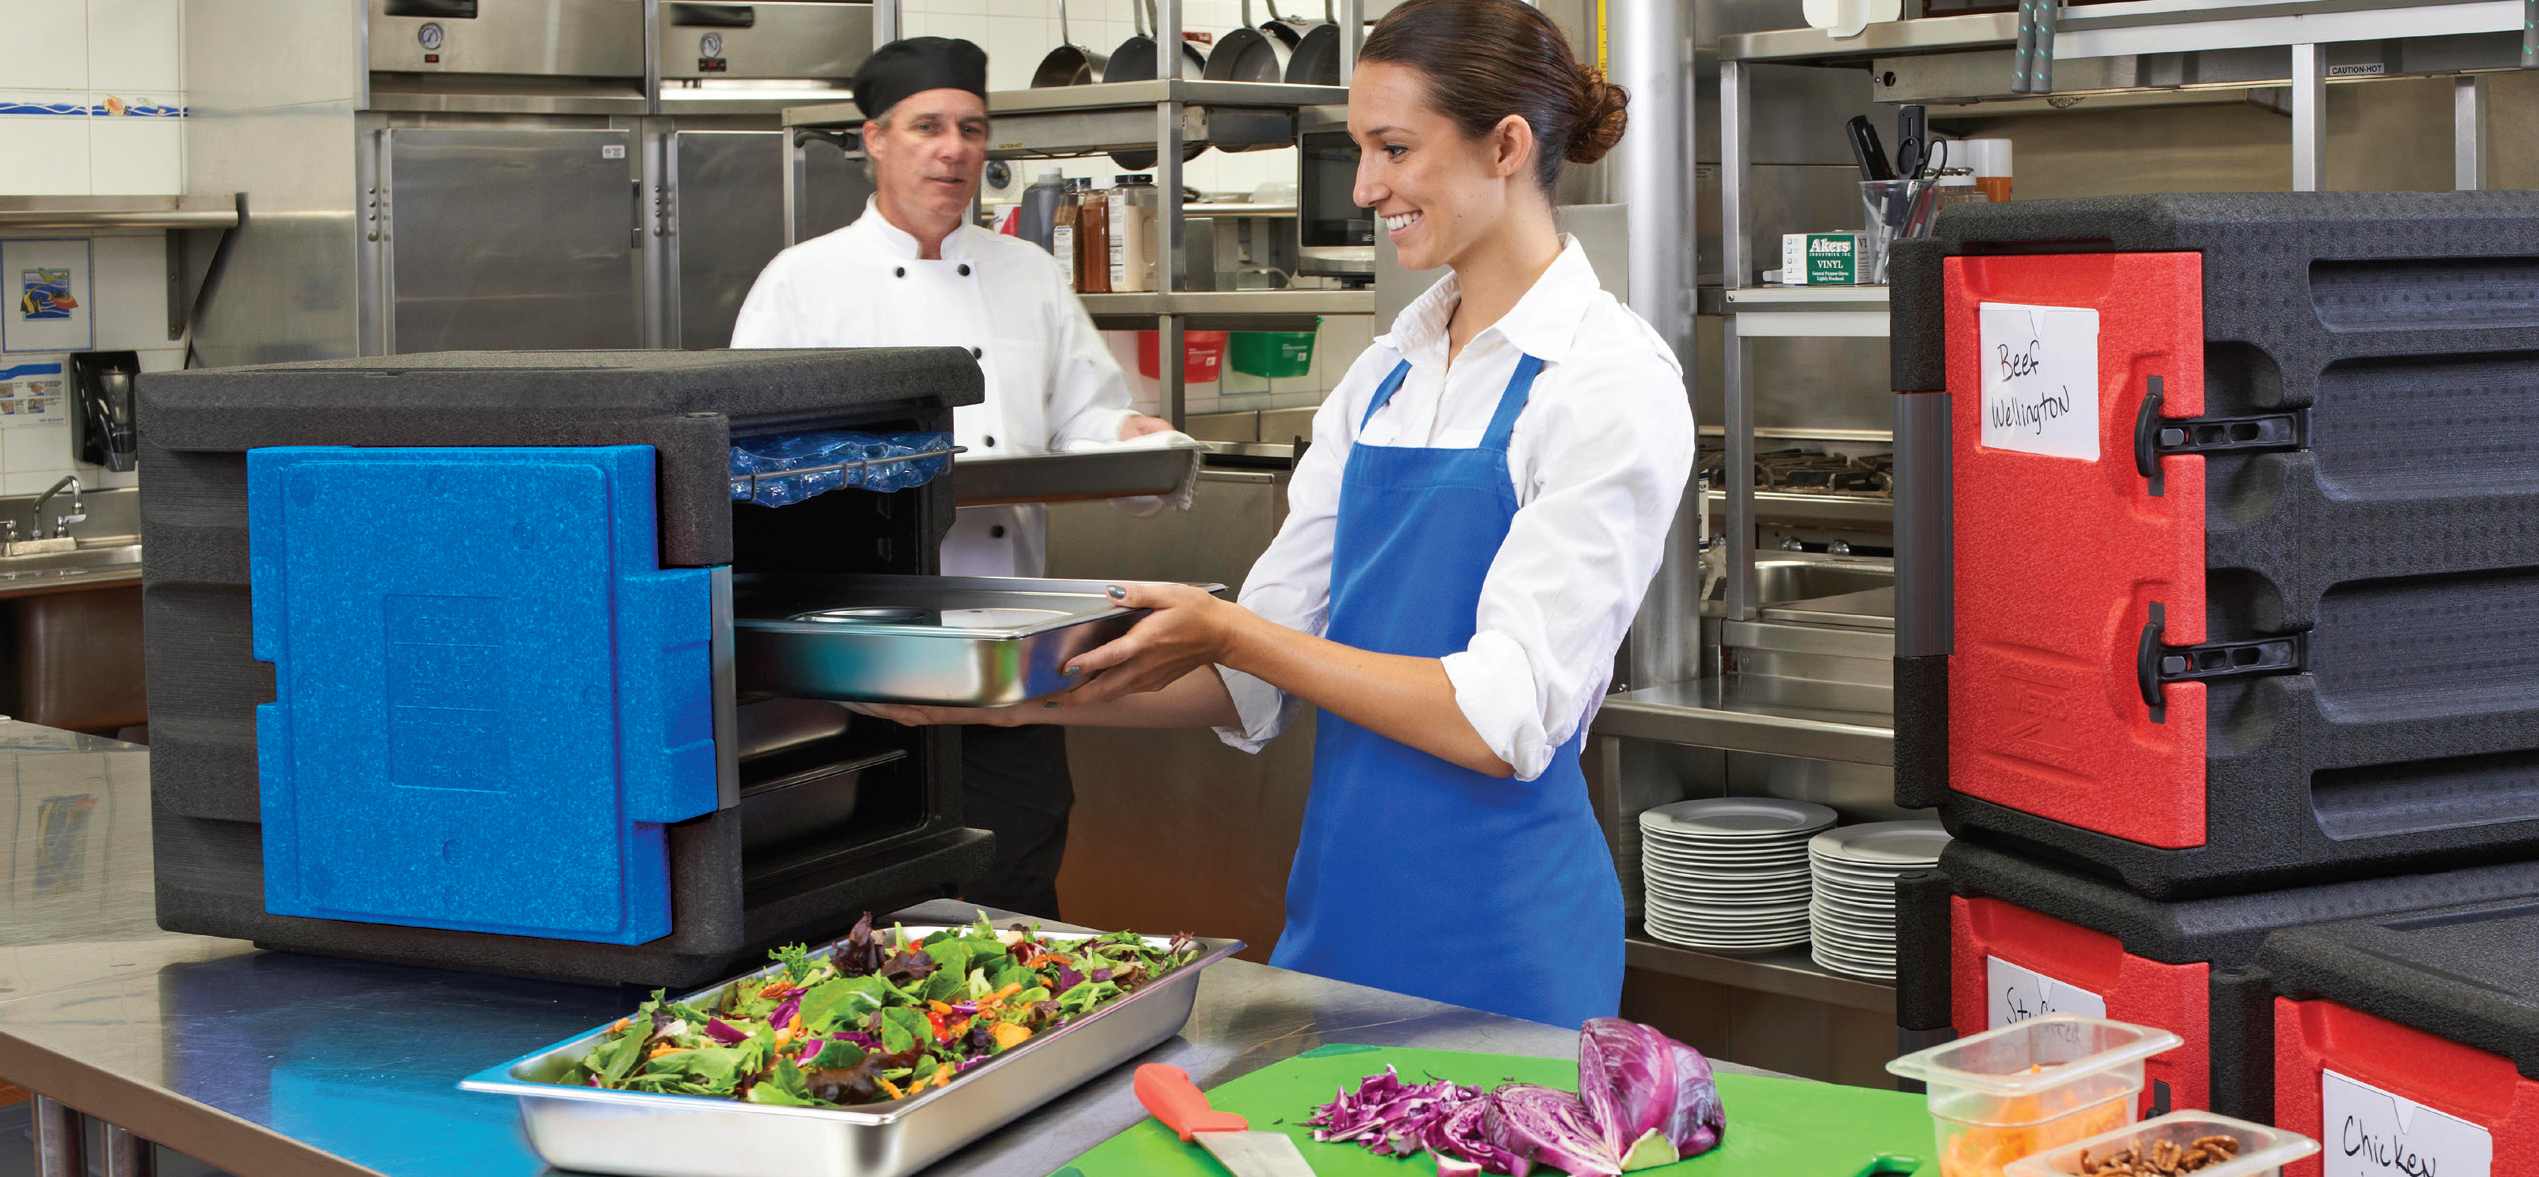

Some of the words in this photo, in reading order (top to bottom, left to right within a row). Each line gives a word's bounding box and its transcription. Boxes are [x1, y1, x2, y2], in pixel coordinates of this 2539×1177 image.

[2332, 64, 2382, 75] CAUTION-HOT
[1809, 238, 1852, 253] Akers
[1817, 260, 1843, 269] VINYL
[1997, 339, 2040, 382] Beef
